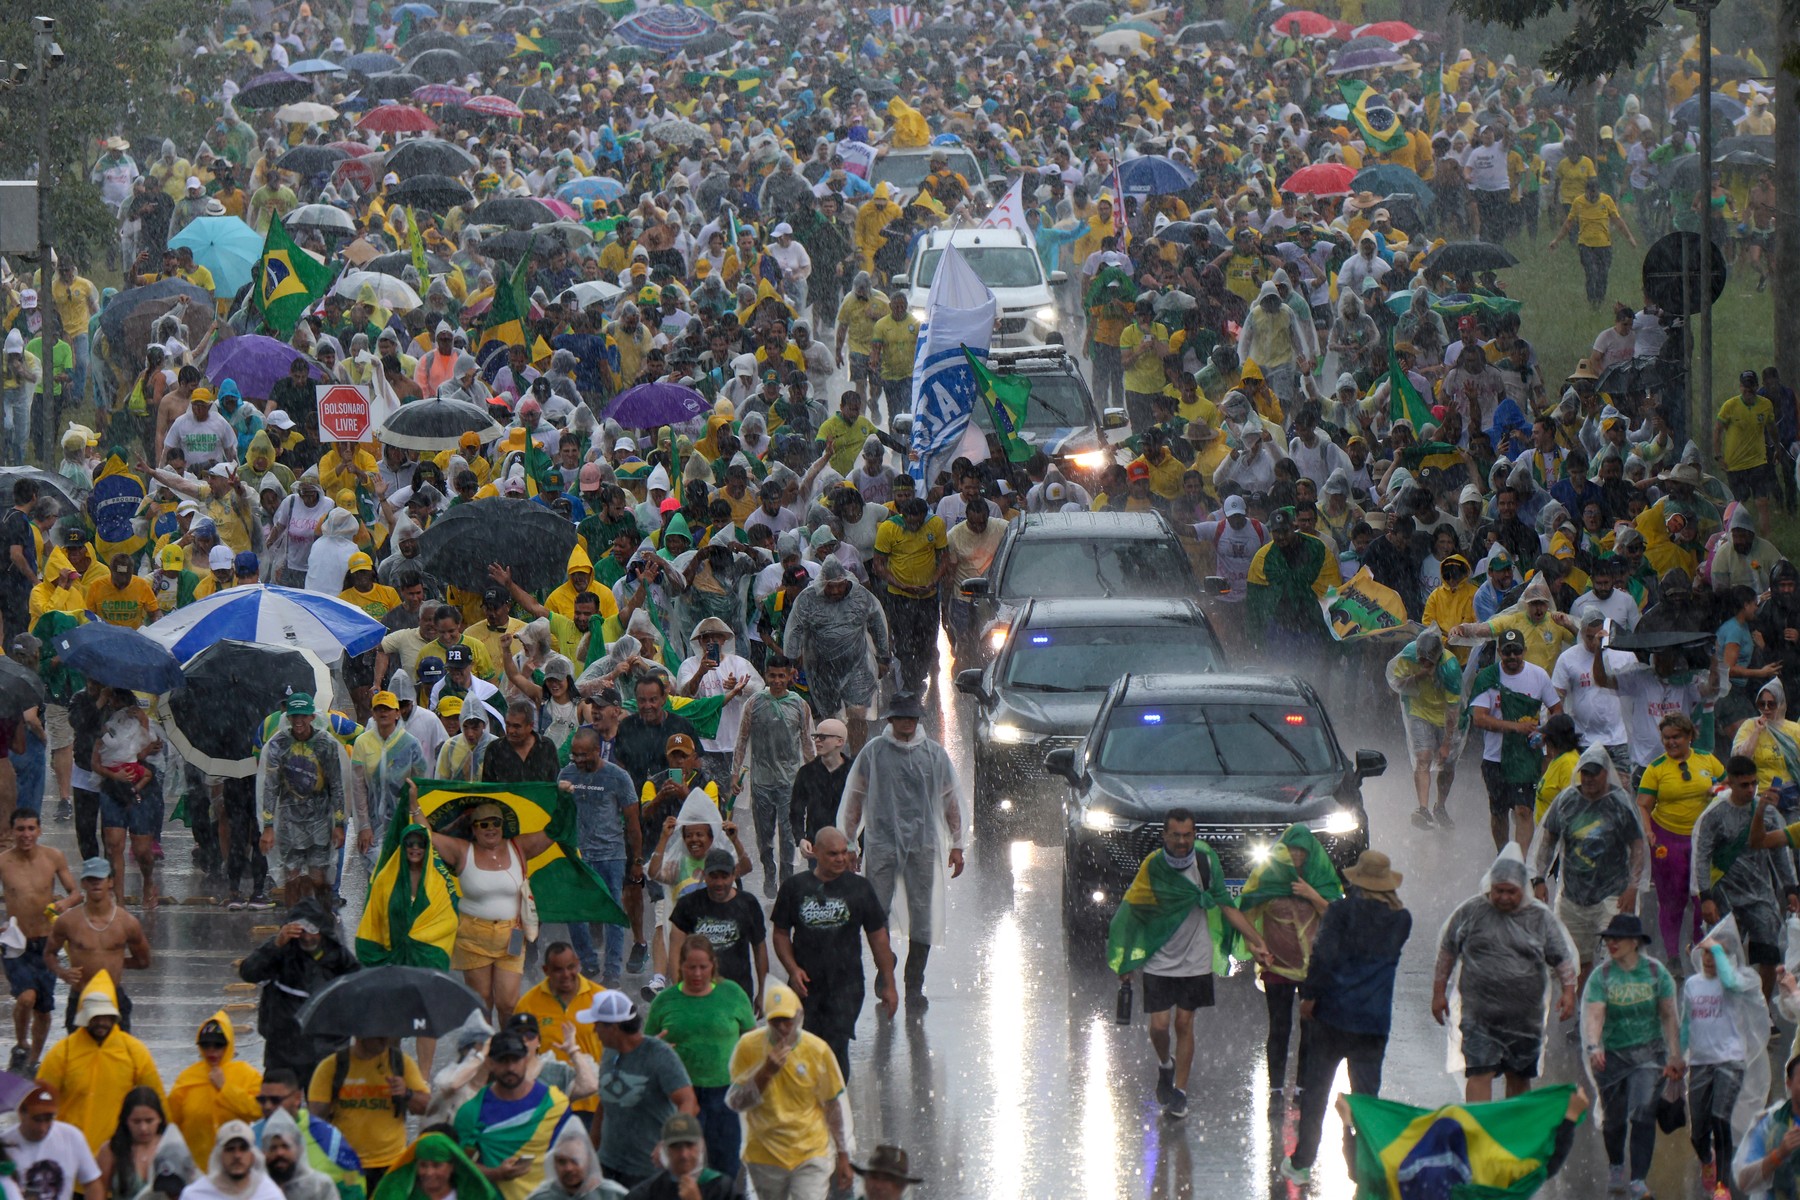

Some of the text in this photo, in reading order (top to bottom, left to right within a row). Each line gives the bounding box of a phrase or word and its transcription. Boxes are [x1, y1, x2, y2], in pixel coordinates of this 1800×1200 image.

[324, 403, 366, 415] BOLSONARO
[335, 418, 359, 431] LIVRE
[69, 533, 79, 542] 22
[448, 650, 462, 661] PR
[338, 1097, 390, 1110] BRASIL
